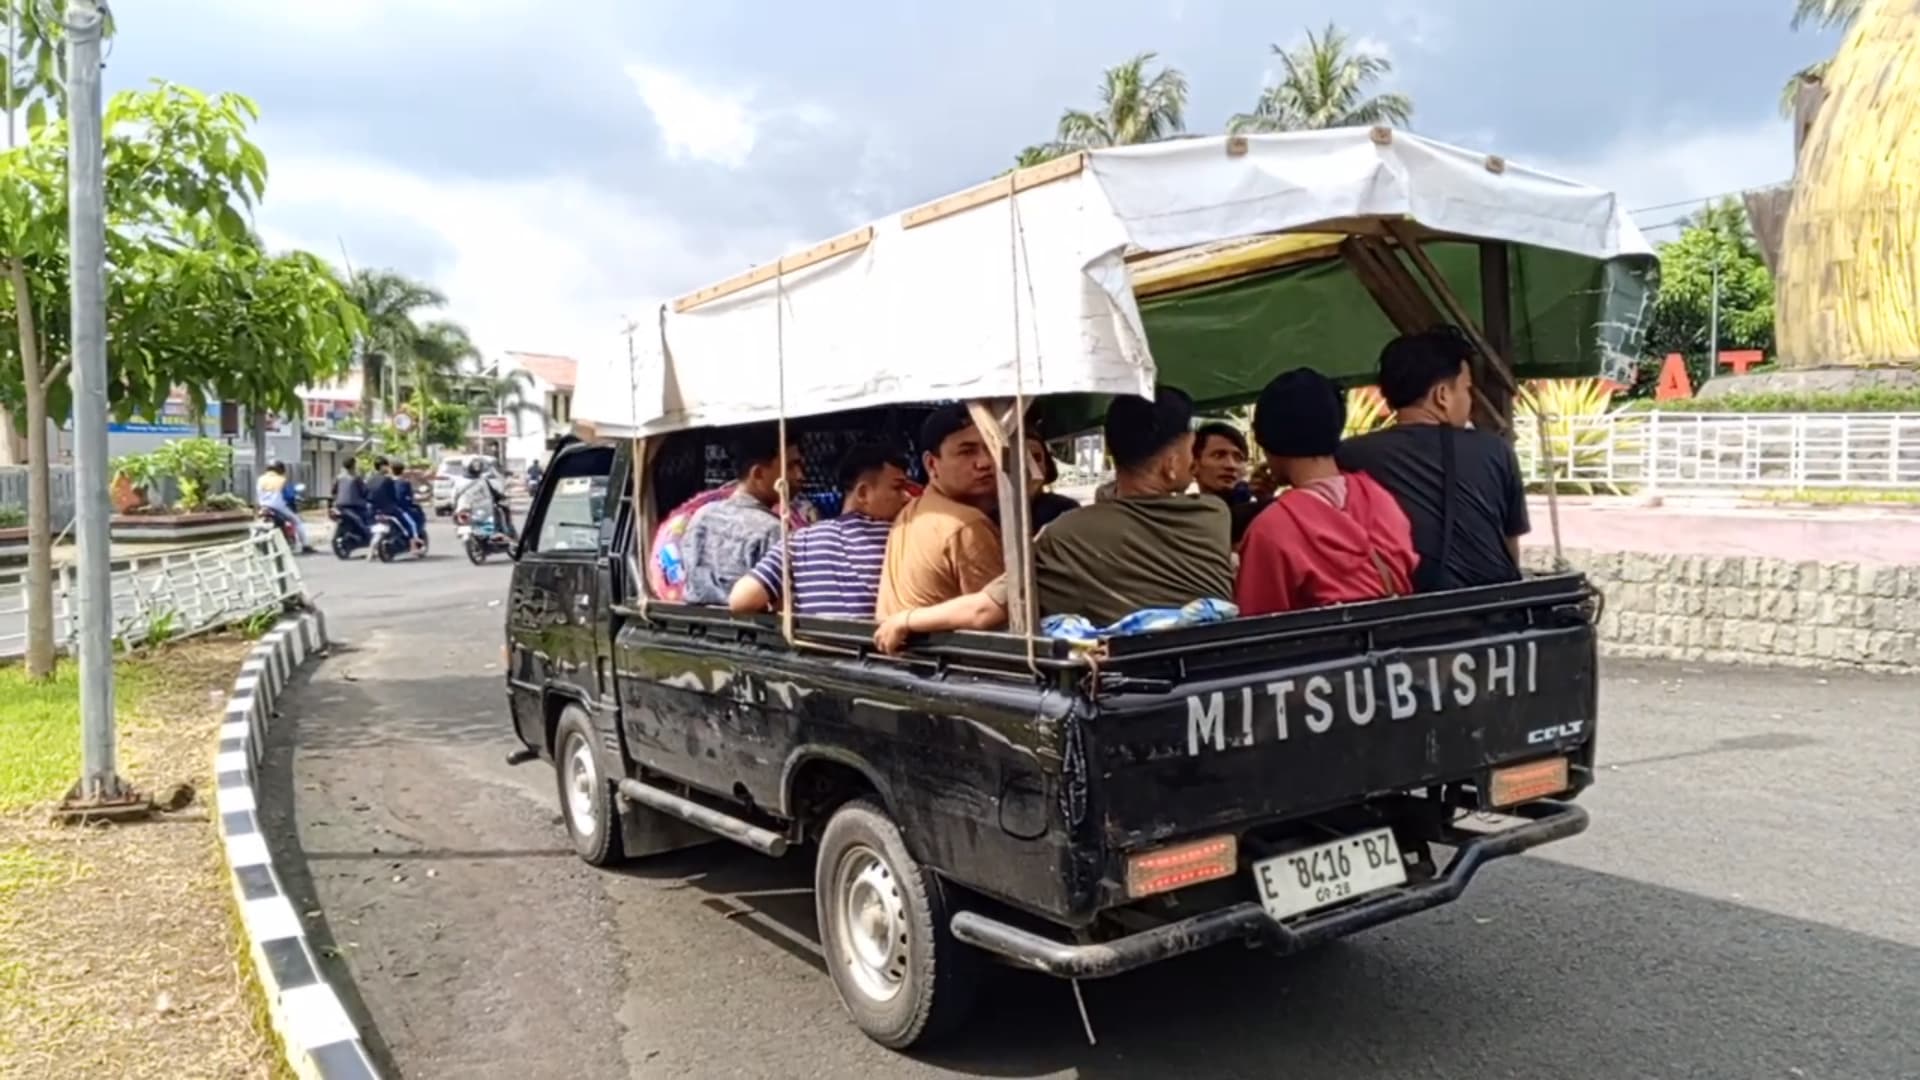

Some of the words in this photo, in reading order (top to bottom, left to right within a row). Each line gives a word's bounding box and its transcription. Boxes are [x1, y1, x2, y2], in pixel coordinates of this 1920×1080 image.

[1186, 641, 1537, 756] MITSUBISHI
[1260, 865, 1279, 899] E
[1295, 845, 1352, 889] 8416
[1362, 833, 1398, 869] BZ
